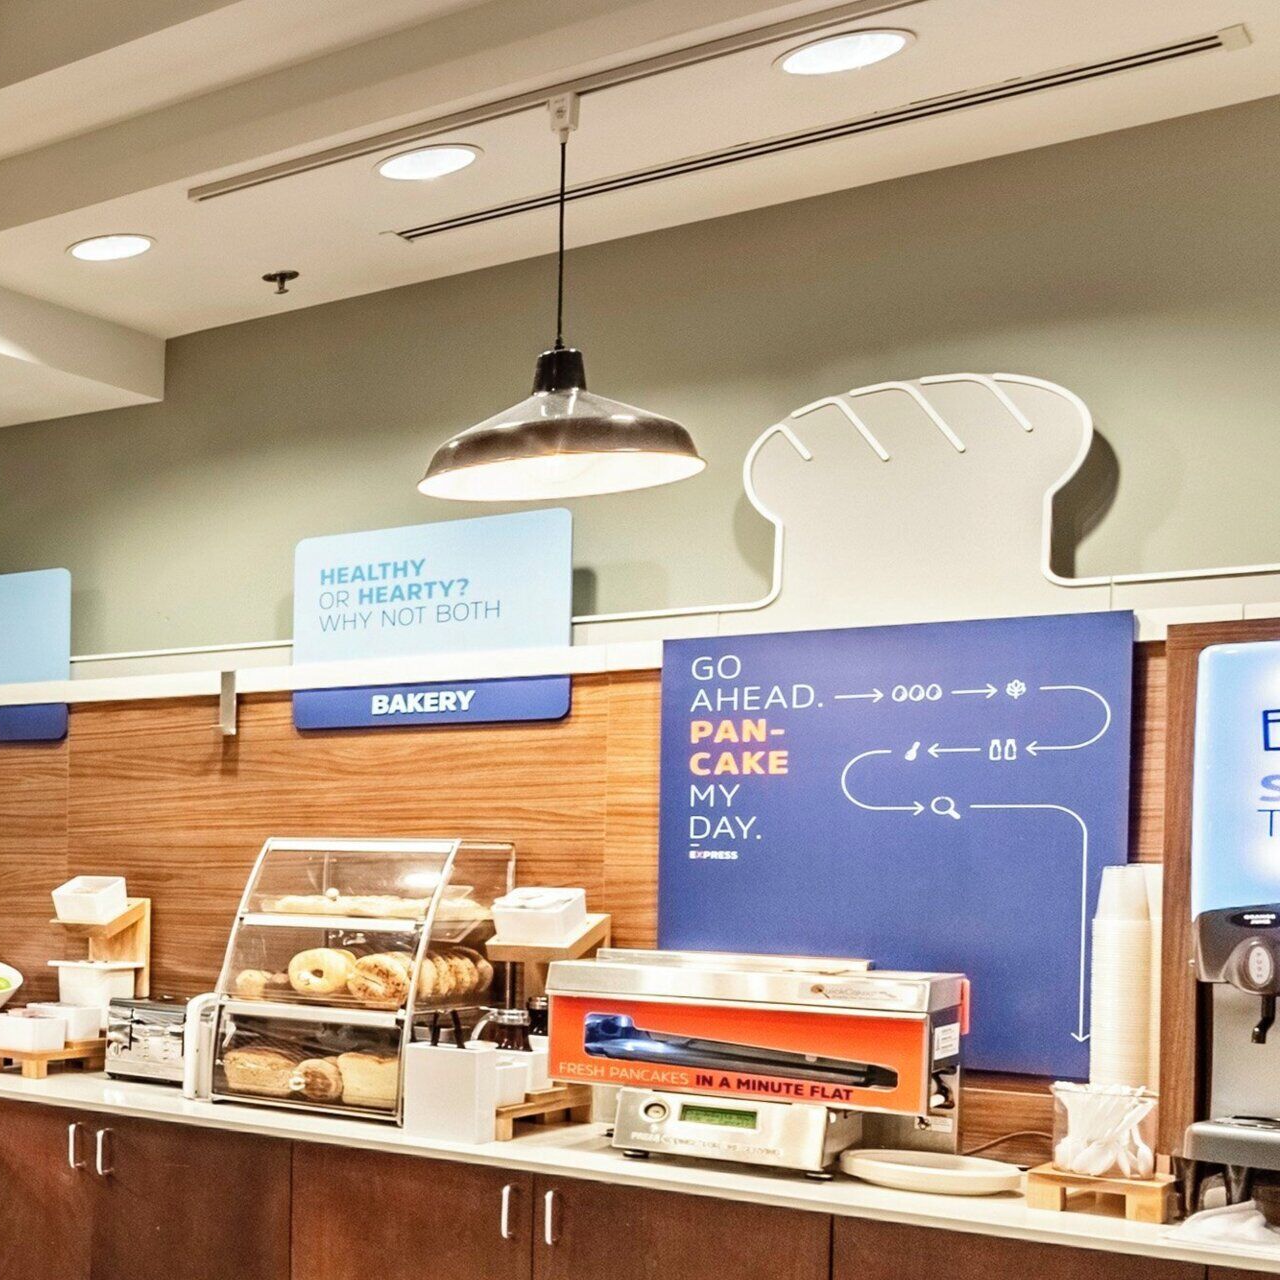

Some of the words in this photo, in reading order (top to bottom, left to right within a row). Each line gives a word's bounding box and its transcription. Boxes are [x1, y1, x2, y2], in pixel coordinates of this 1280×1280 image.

[320, 558, 426, 586] HEALTHY
[319, 590, 350, 610] OR
[358, 578, 470, 606] HEARTY?
[319, 611, 373, 633] WHY
[381, 606, 427, 627] NOT
[436, 600, 501, 624] BOTH
[690, 654, 742, 681] GO
[371, 690, 476, 716] BAKERY
[689, 684, 824, 713] AHEAD.
[689, 718, 786, 745] PAN-
[689, 750, 790, 776] CAKE
[689, 783, 741, 808] MY
[689, 815, 763, 840] DAY.
[689, 850, 738, 860] EXPRESS
[559, 1062, 605, 1077] FRESH
[609, 1066, 689, 1085] PANCAKES
[696, 1074, 713, 1087] IN
[719, 1077, 731, 1089] A
[736, 1078, 804, 1096] MINUTE
[810, 1085, 854, 1101] FLAT
